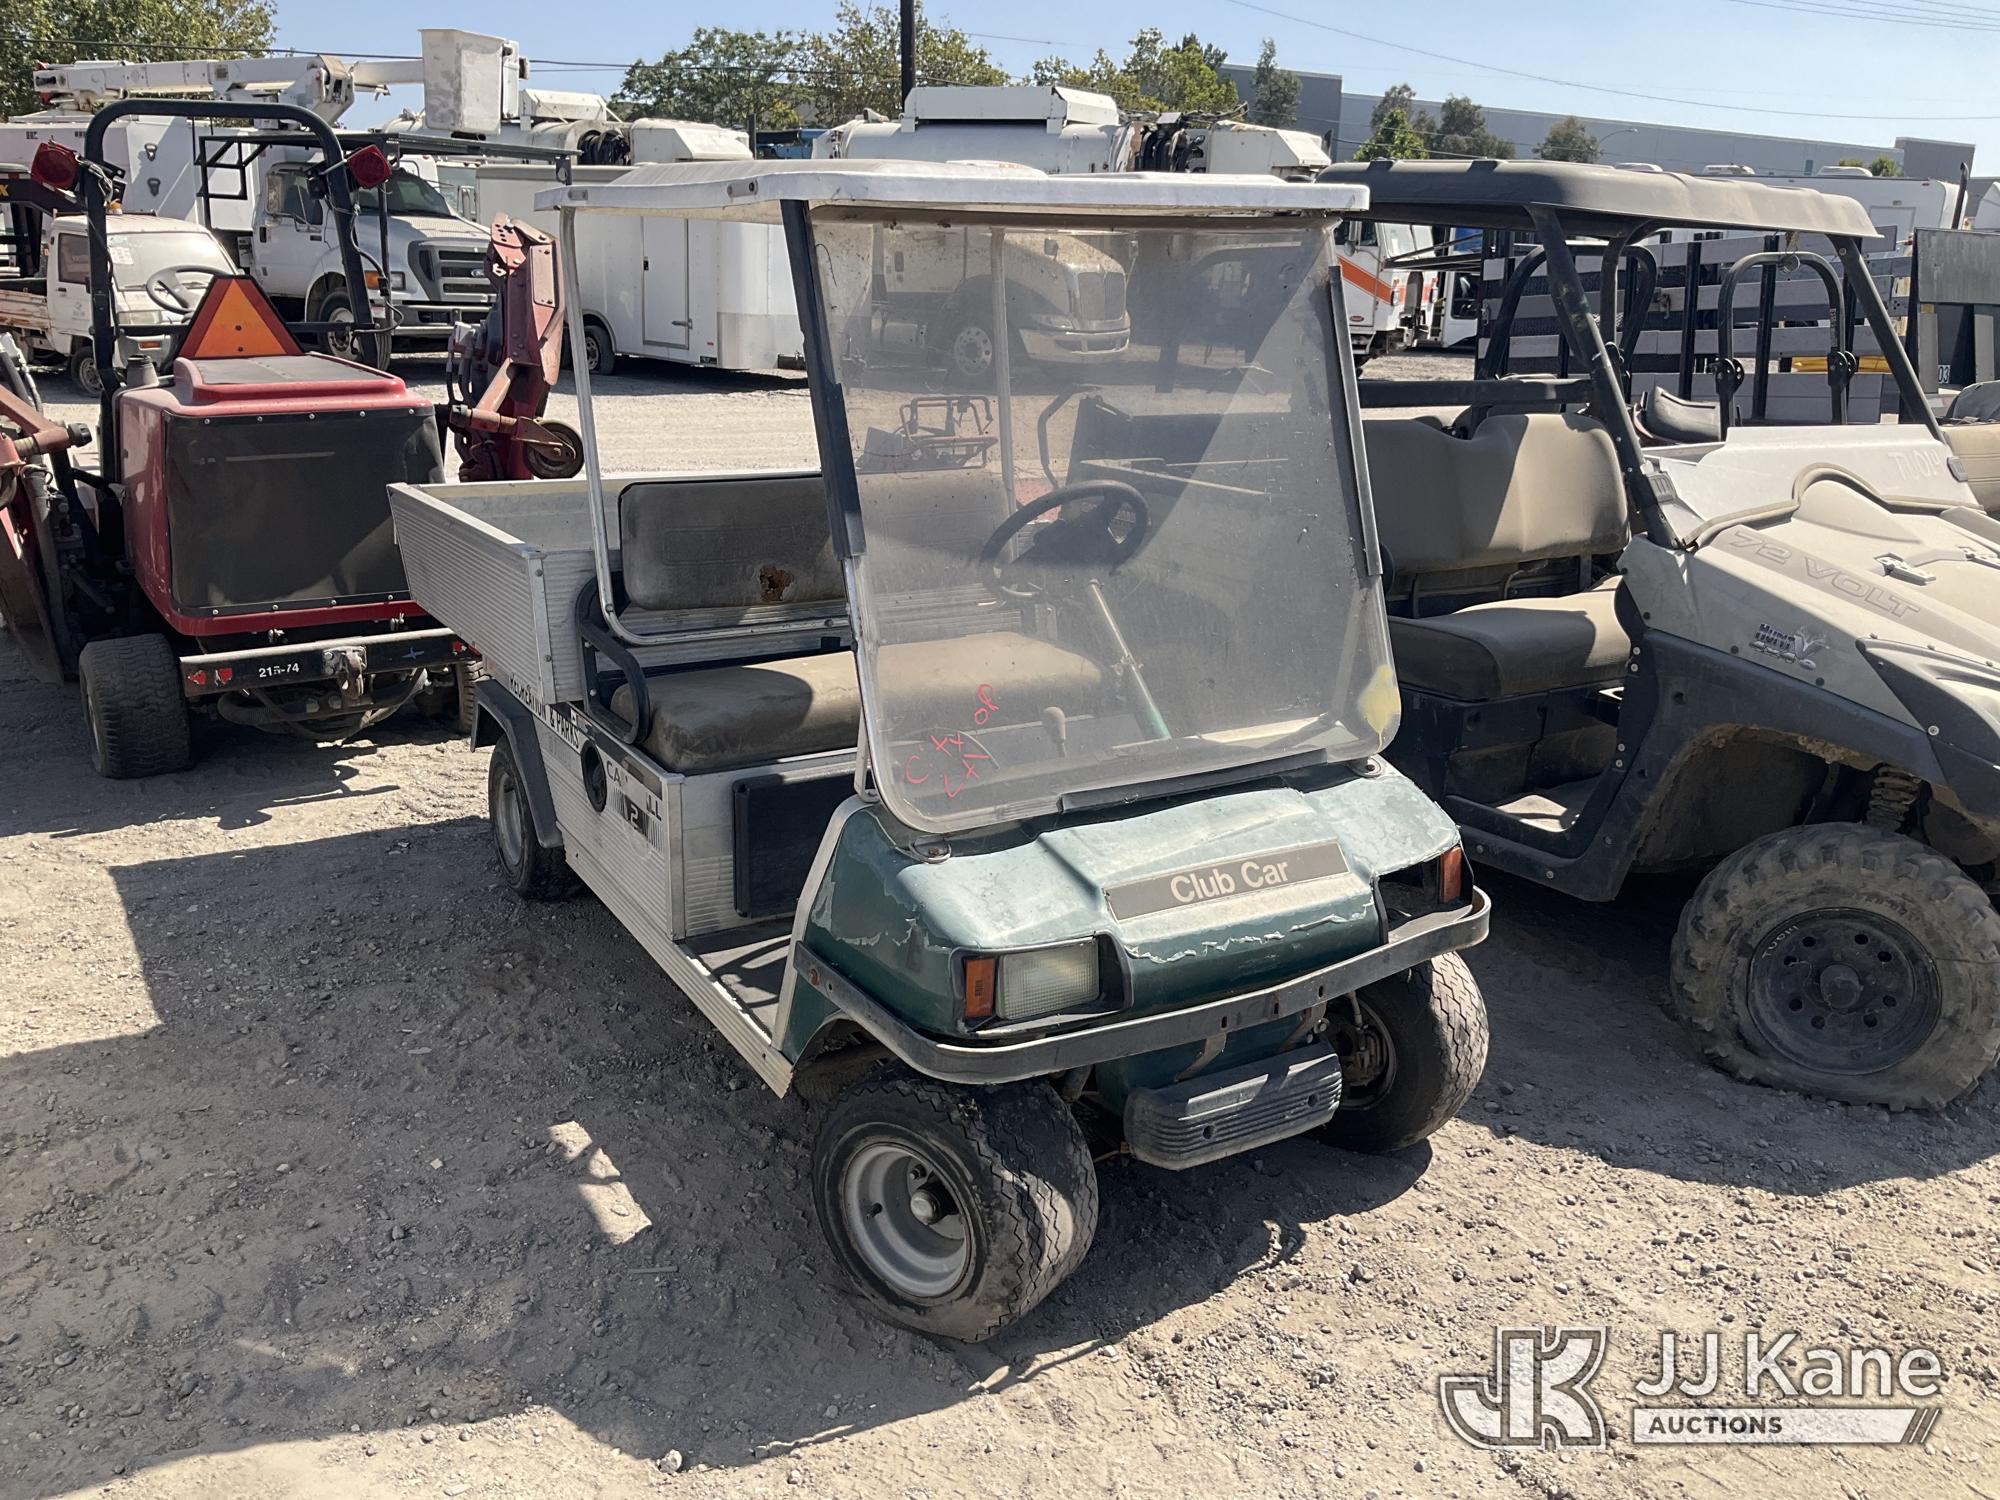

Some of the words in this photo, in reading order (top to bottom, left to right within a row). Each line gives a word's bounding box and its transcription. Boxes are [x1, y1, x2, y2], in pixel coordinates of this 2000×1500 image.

[1730, 531, 1792, 565] 72
[1804, 556, 1921, 618] VOLT
[556, 712, 580, 750] PARKS
[1171, 868, 1236, 903] Club
[1240, 861, 1290, 889] Car
